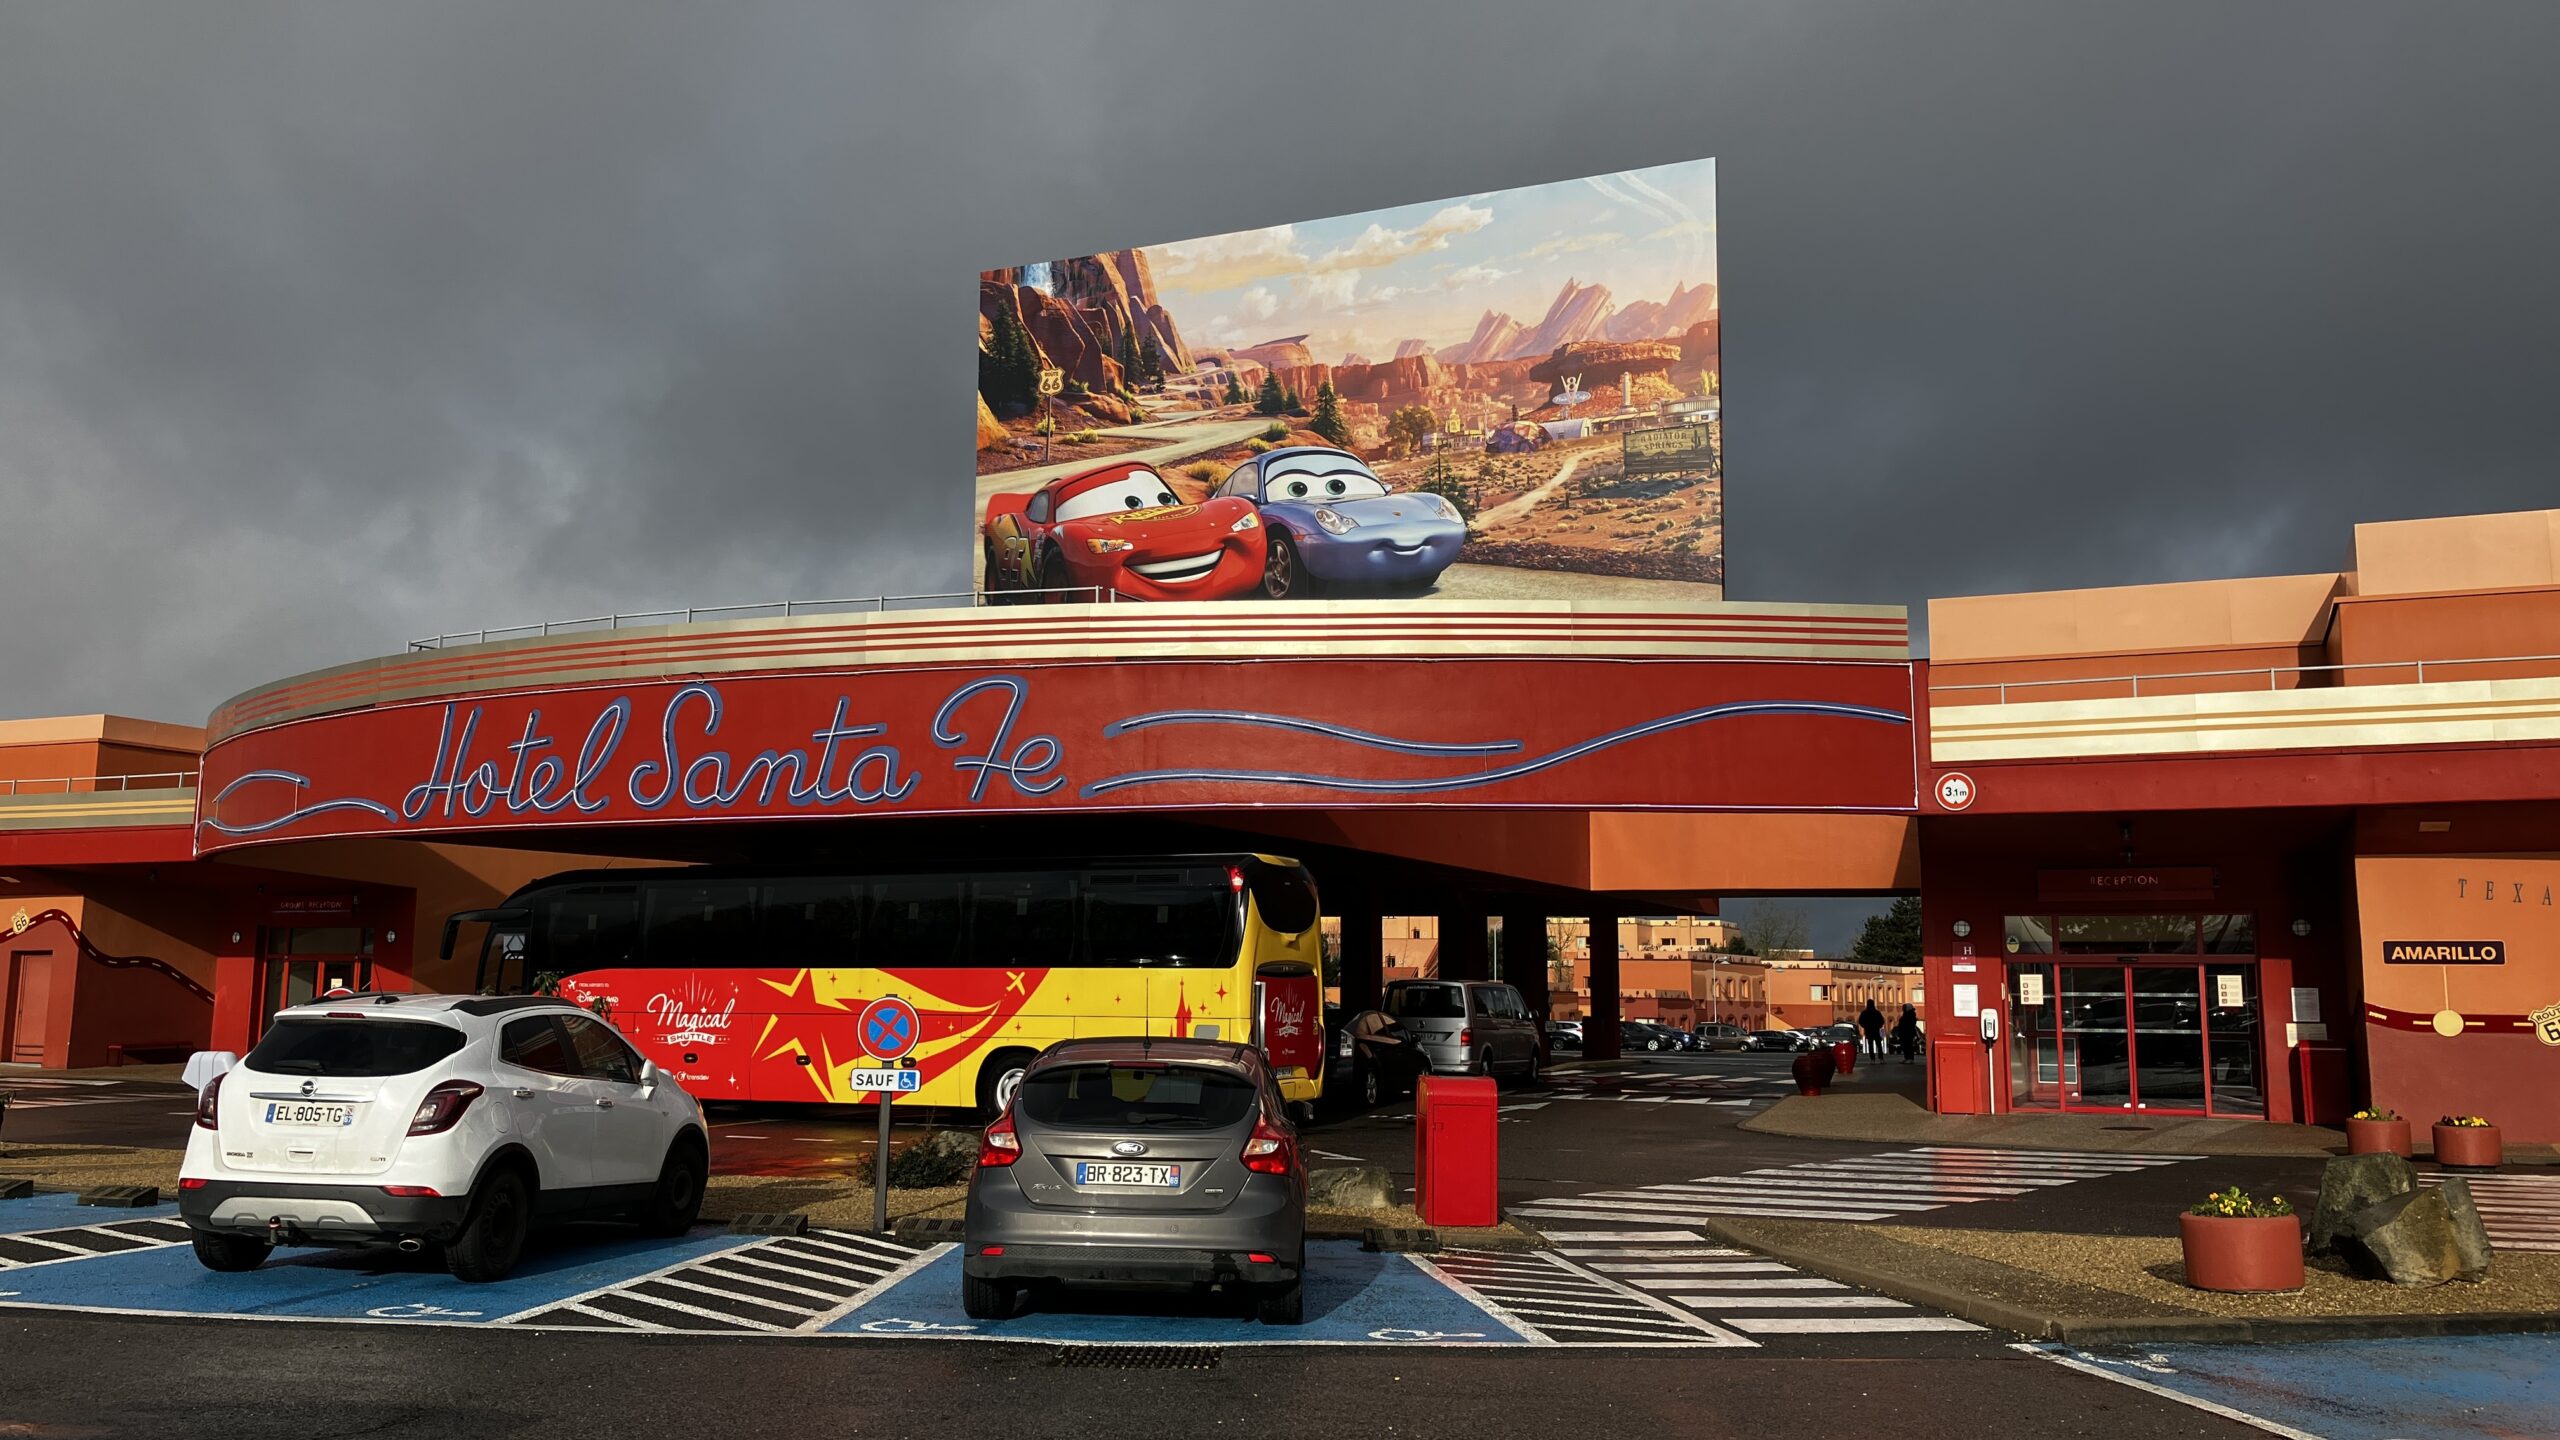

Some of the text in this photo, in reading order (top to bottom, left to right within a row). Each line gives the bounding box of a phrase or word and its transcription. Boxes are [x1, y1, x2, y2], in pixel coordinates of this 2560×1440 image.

[1042, 377, 1060, 391] 66
[1640, 432, 1687, 442] RADIATOR
[1644, 442, 1684, 451] SPRINGS
[403, 675, 1068, 821] Hotel Santa Fe
[2090, 875, 2159, 886] RECEPTION
[15, 915, 27, 931] 66
[1963, 946, 1972, 955] H
[2391, 946, 2497, 960] AMARILLO
[647, 993, 735, 1038] Magical
[669, 1032, 713, 1043] SHUTTLE
[856, 1073, 894, 1086] SAUF
